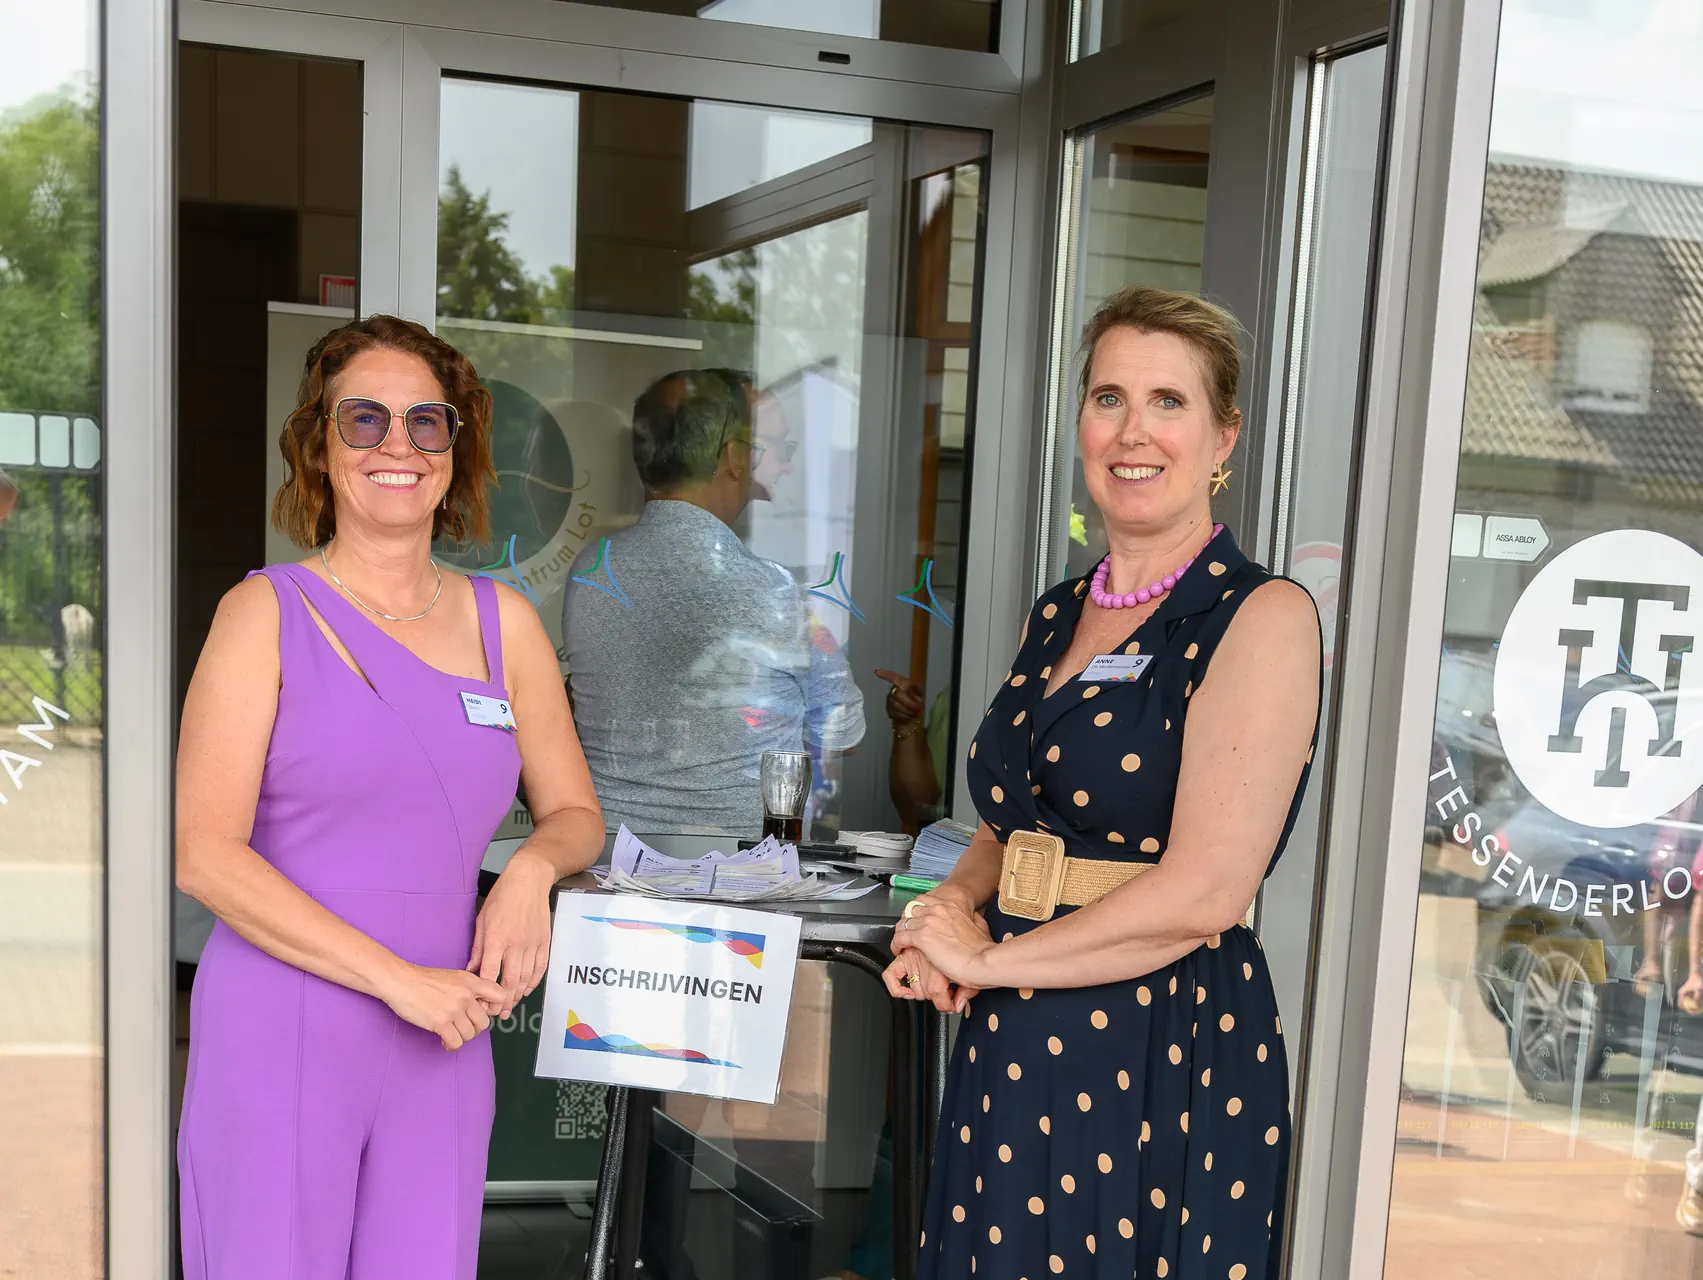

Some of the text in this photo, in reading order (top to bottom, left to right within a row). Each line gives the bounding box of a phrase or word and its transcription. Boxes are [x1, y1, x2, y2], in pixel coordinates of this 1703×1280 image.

[566, 501, 597, 541] Lot
[1496, 534, 1537, 544] ASSA ABLOY
[1132, 658, 1144, 668] 9
[500, 703, 508, 714] 9
[0, 696, 71, 804] AM
[1429, 756, 1703, 917] TESSENDERLO
[567, 965, 763, 1004] INSCHRIJVINGEN
[1679, 1121, 1696, 1130] 117
